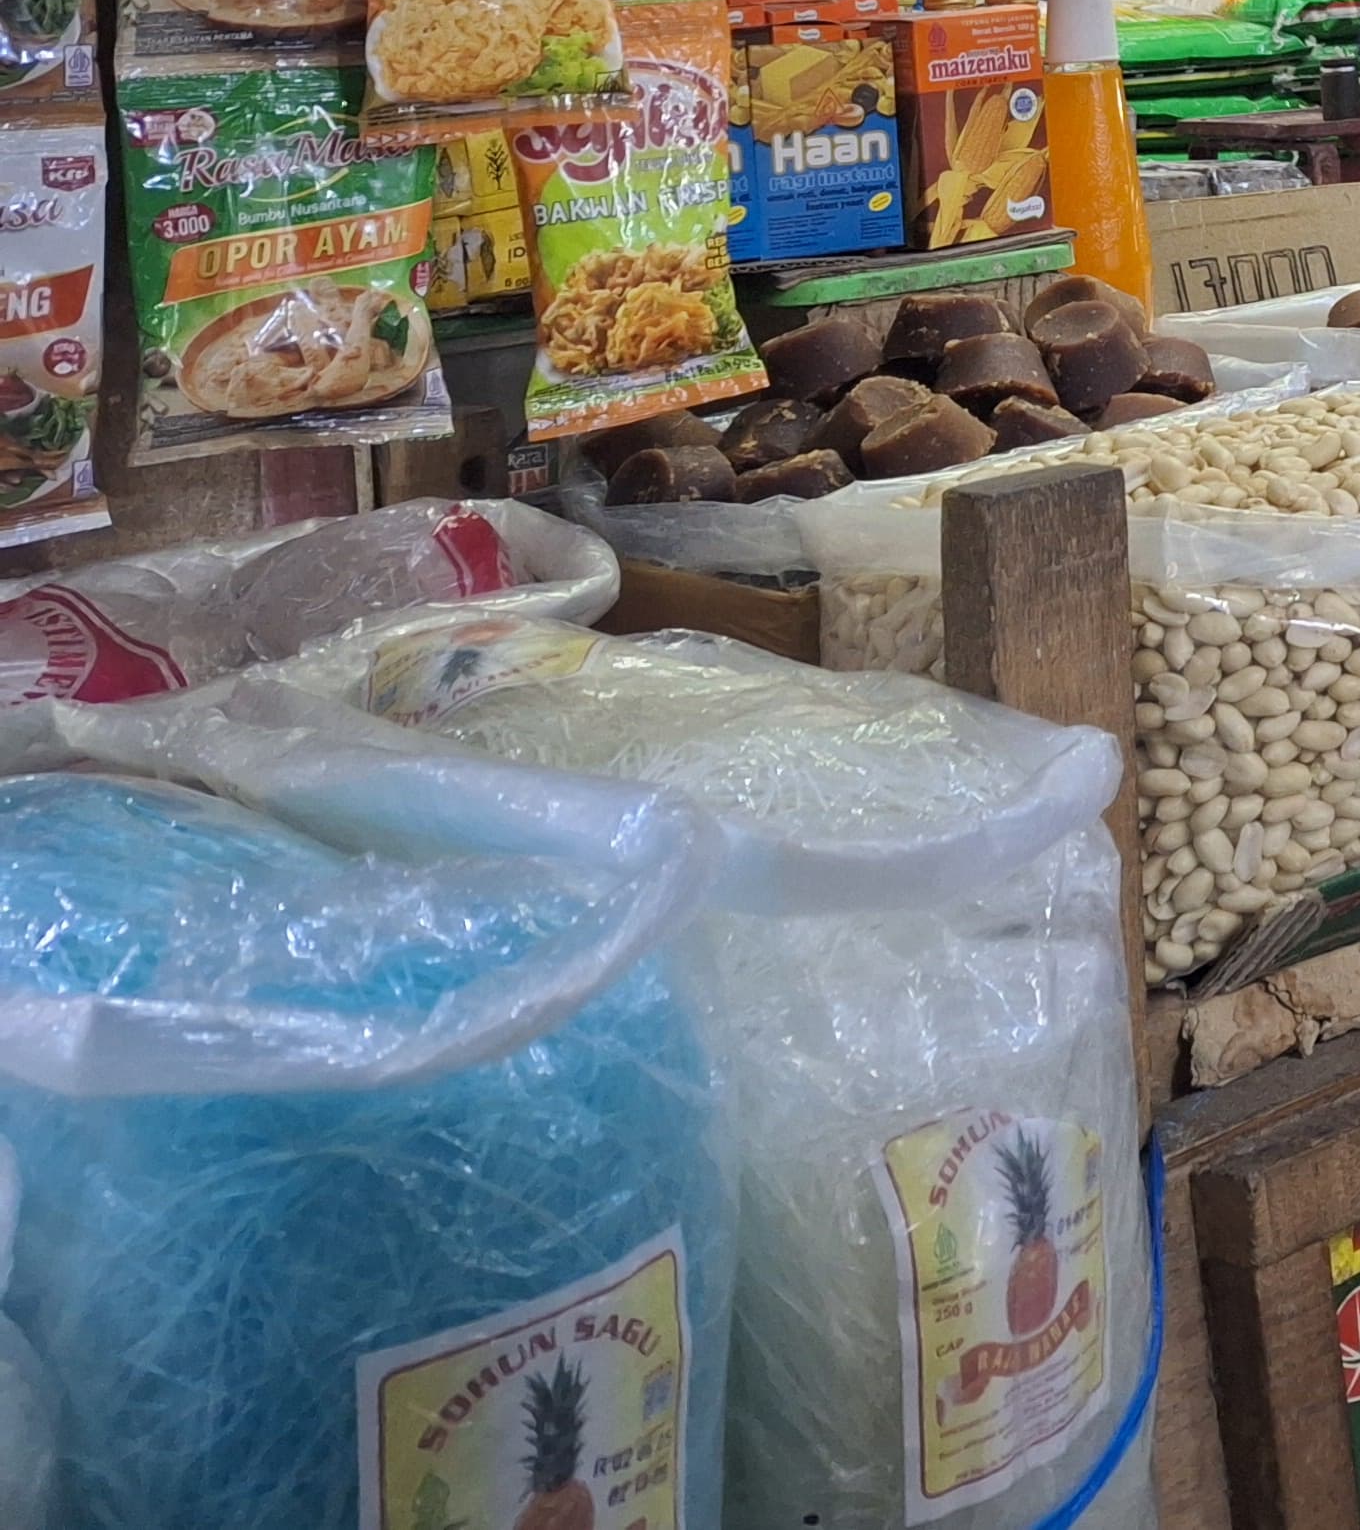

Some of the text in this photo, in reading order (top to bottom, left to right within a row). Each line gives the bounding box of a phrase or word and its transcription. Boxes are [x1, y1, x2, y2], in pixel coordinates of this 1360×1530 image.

[929, 50, 1030, 82] maizenaku
[772, 129, 889, 175] Haan
[769, 165, 895, 192] ragi instant
[237, 196, 367, 226] Bumbu Nusantara
[534, 192, 649, 227] BAKWAN
[162, 216, 211, 239] 3.000
[199, 216, 410, 278] OPOR AYAM
[1170, 244, 1339, 314] 17000
[927, 1110, 1013, 1211] SOHUN
[934, 1337, 964, 1358] CAP
[416, 1325, 558, 1454] SOHUN
[573, 1312, 663, 1359] SAGU
